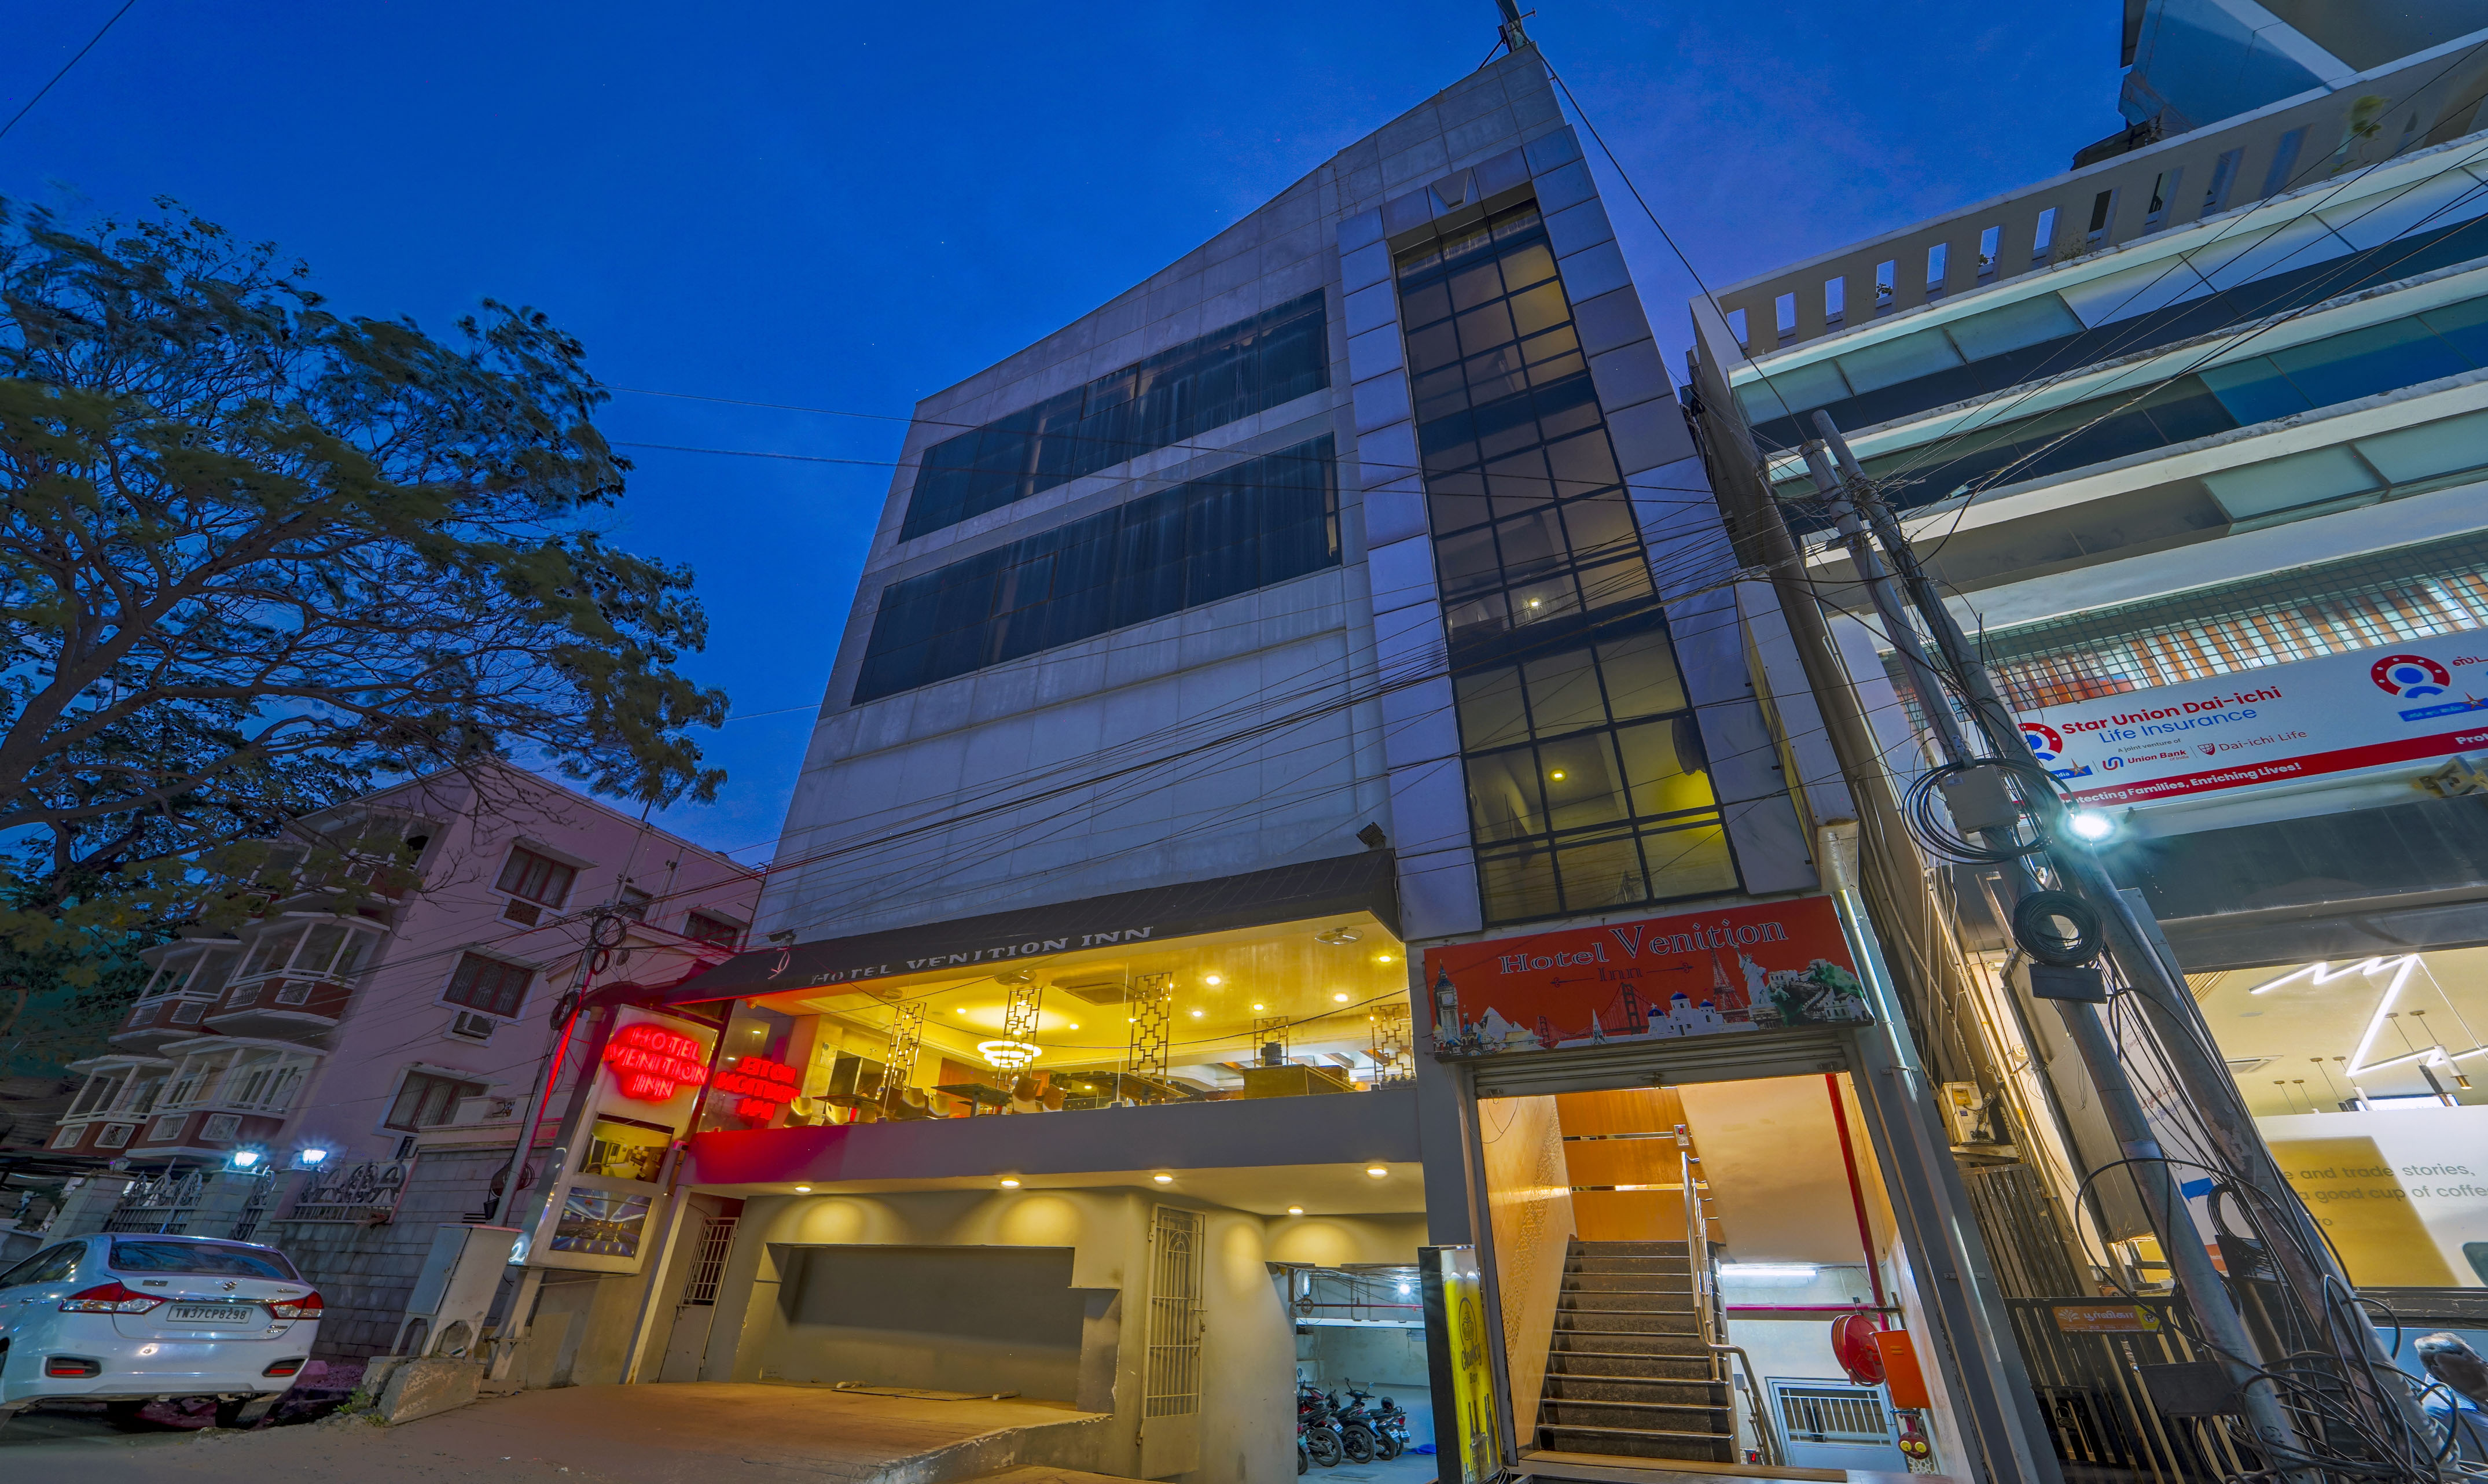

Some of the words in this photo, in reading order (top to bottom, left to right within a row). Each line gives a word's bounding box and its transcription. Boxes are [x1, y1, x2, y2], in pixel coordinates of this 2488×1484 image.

[2061, 719, 2107, 734] Star
[2111, 706, 2181, 726] Union
[2182, 686, 2283, 713] Dai-ichi
[2099, 730, 2137, 743] Life
[2141, 709, 2257, 735] Insurance
[2219, 735, 2274, 751] Dai-ichi
[2278, 731, 2308, 741] Life
[2125, 744, 2141, 752] joint
[2142, 740, 2171, 749] venture
[2127, 754, 2158, 764] Union
[2159, 749, 2187, 758] Bank
[2127, 780, 2189, 796] Families,
[2190, 771, 2259, 786] Enriching
[2259, 762, 2302, 776] Lives!
[810, 964, 892, 985] HOTEL
[906, 937, 1069, 970] VENITION
[1081, 926, 1153, 946] INN
[1499, 941, 1609, 974] Hotel
[1609, 919, 1789, 959] Venition
[1597, 967, 1643, 982] Inn
[630, 1027, 700, 1061] HOTEL
[604, 1044, 708, 1085] VENITION
[632, 1073, 675, 1099] INN
[2300, 1166, 2338, 1179] and
[2342, 1165, 2394, 1178] trade
[2402, 1163, 2476, 1177] stories,
[2315, 1188, 2366, 1203] good
[2368, 1189, 2405, 1201] cup
[2412, 1186, 2431, 1198] of
[2436, 1184, 2488, 1197] coffe
